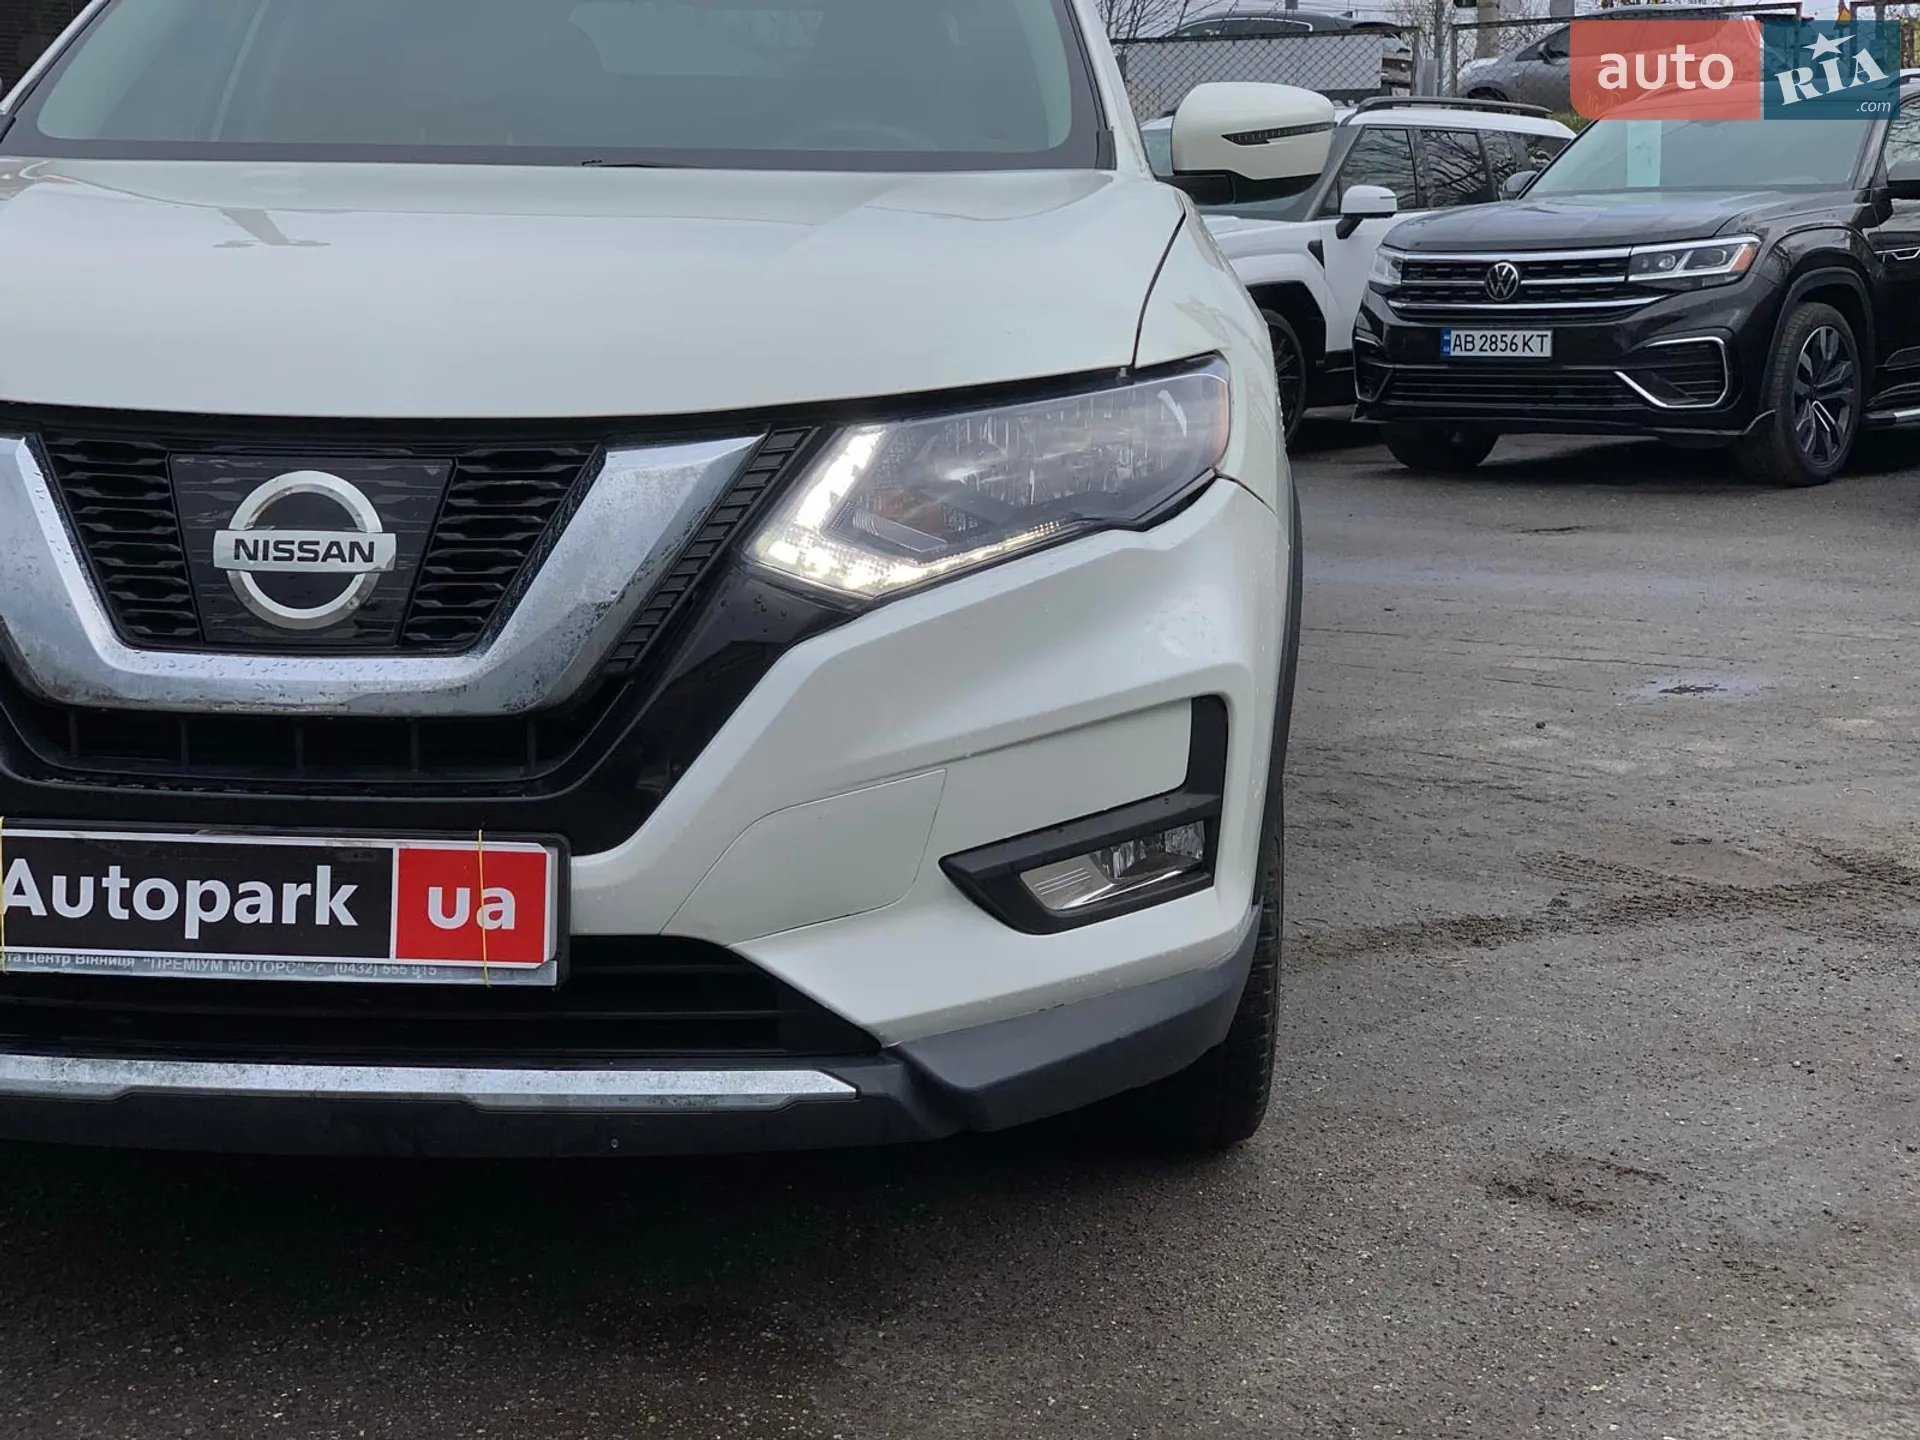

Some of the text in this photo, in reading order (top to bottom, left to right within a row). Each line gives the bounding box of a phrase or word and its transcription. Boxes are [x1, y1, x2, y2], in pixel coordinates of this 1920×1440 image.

[1453, 333, 1475, 352] AB
[1479, 333, 1519, 352] 2856
[1522, 333, 1549, 352] KT
[233, 538, 375, 563] NISSAN
[2, 858, 516, 940] Autopark ua
